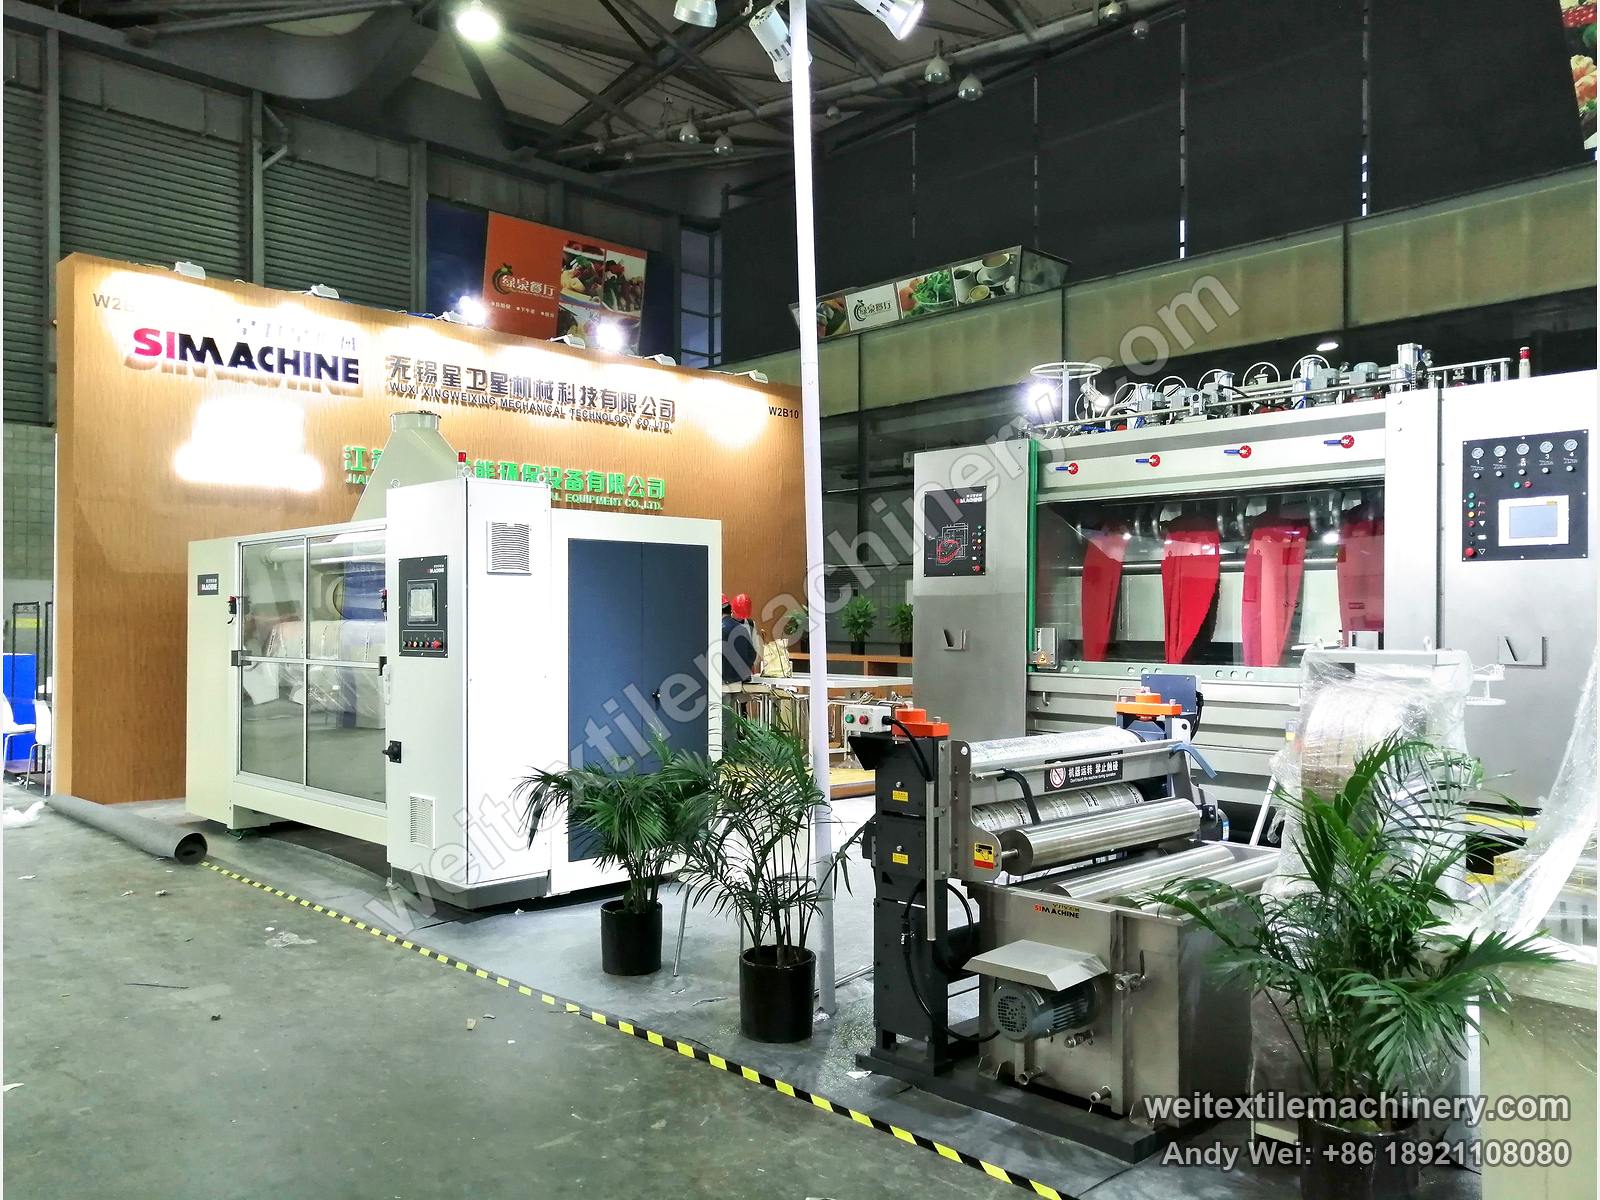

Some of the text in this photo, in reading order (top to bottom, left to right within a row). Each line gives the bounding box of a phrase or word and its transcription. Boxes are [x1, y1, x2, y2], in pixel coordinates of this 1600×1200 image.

[133, 328, 359, 384] SIMACHINE
[387, 355, 676, 420] 无锡星卫星机械科技有限公司
[389, 382, 419, 395] WUXI
[424, 387, 496, 405] XINGWEIXING
[501, 398, 566, 416] MECHANICAL
[571, 408, 634, 424] TECHNOLOGY
[768, 406, 799, 419] W2B10
[466, 459, 666, 499] 能环保设备有限公司
[565, 493, 623, 507] EQUIPMENT
[1068, 764, 1093, 778] 机器运转
[1032, 903, 1080, 919] SIMACHINE
